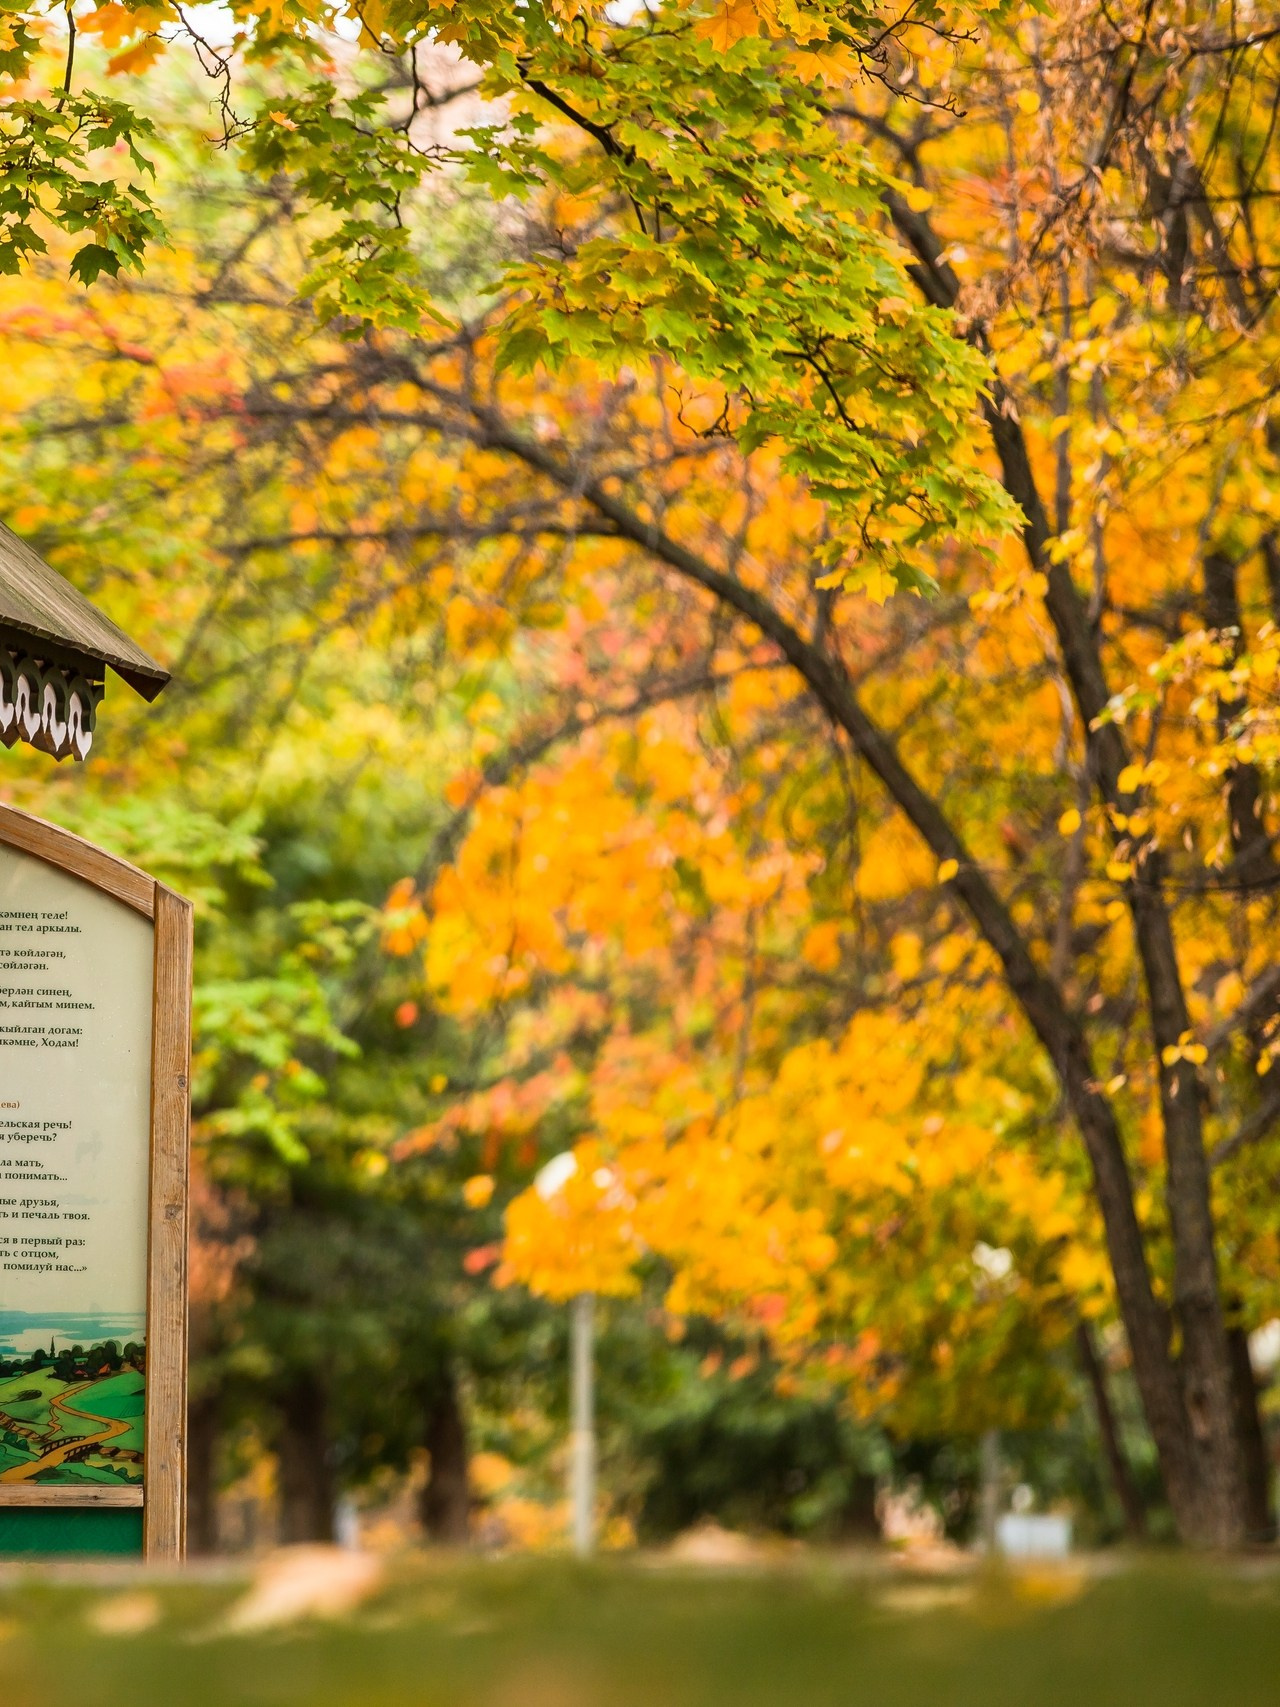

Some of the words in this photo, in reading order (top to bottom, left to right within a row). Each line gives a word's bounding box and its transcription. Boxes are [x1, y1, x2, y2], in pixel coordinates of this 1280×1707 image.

[40, 910, 68, 921] теле!
[14, 924, 34, 932] тел
[35, 924, 82, 935] аркылы.
[13, 948, 67, 960] көйләгән,
[36, 988, 73, 998] синең,
[11, 999, 53, 1009] кайгым
[55, 1001, 95, 1010] минем.
[47, 1027, 83, 1036] догам:
[40, 1037, 79, 1049] Ходам!
[43, 1120, 72, 1132] речь!
[6, 1131, 58, 1145] уберечь?
[14, 1159, 45, 1169] мать,
[4, 1172, 68, 1181] понимать...
[19, 1198, 60, 1209] друзья,
[11, 1211, 19, 1219] и
[21, 1211, 60, 1220] печаль
[62, 1212, 91, 1221] твоя.
[12, 1237, 19, 1245] в
[20, 1236, 63, 1248] первый
[65, 1238, 86, 1249] раз:
[12, 1250, 19, 1258] с
[20, 1250, 60, 1260] отцом,
[3, 1262, 53, 1275] помилуй
[55, 1264, 88, 1272] нас...»
